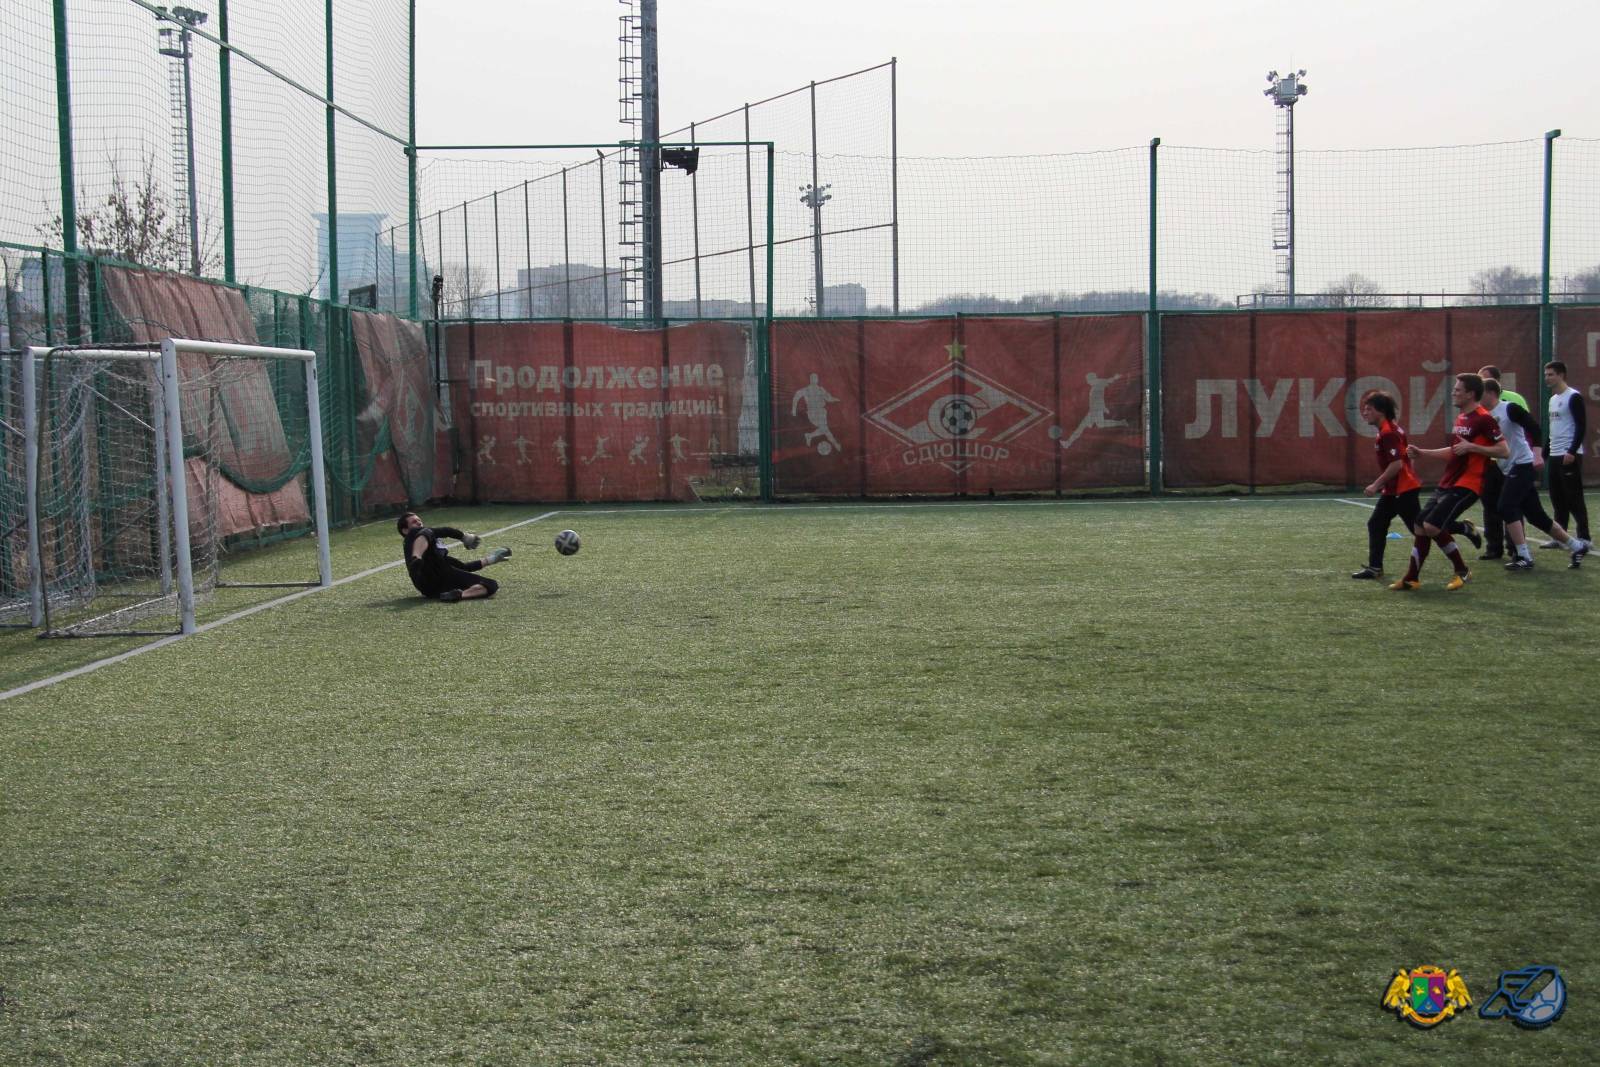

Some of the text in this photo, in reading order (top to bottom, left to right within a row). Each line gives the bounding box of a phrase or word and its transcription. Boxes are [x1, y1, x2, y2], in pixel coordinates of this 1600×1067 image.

[469, 359, 725, 395] Продолжение
[470, 396, 724, 422] спортивных традиций!
[1184, 358, 1516, 440] ЛУКОЙ
[902, 441, 1010, 466] СДЮШОР
